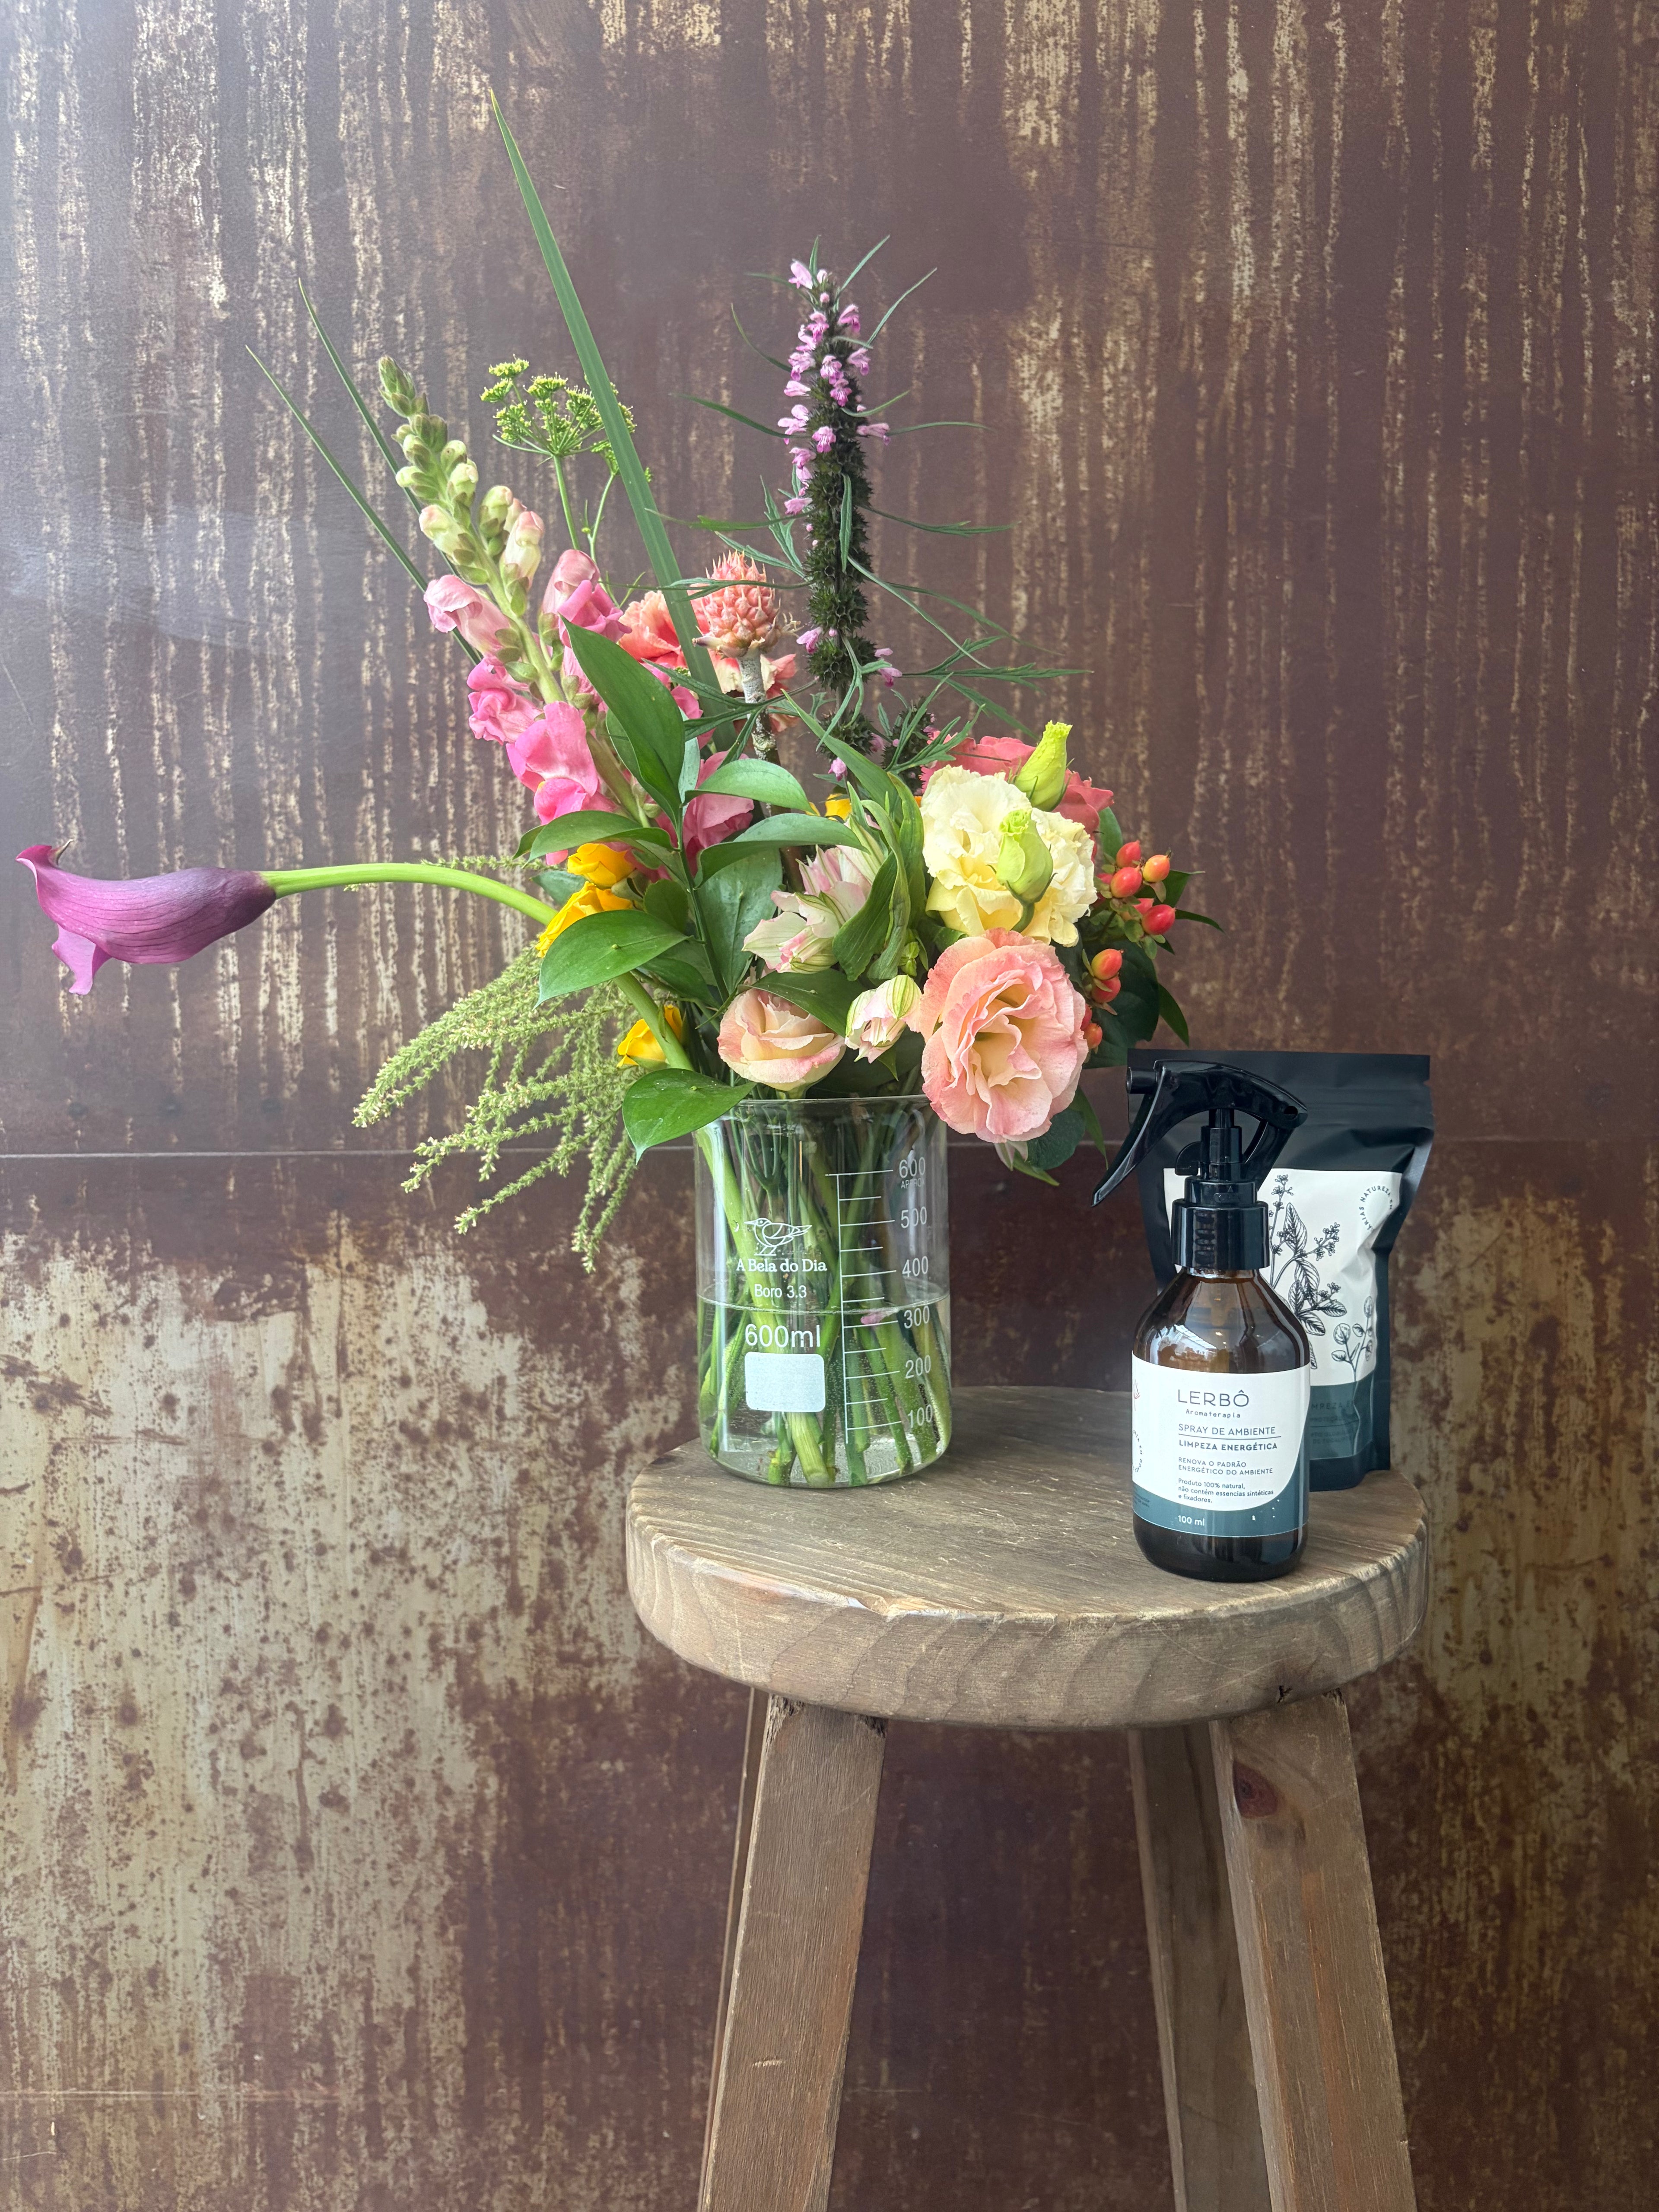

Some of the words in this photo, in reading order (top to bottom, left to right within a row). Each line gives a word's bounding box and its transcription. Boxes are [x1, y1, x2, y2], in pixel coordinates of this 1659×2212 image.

[899, 1157, 926, 1179] 600
[1360, 1185, 1391, 1202] NATUREZA
[900, 1206, 927, 1229] 500
[736, 1258, 746, 1271] A
[747, 1258, 778, 1272] Bela
[780, 1258, 799, 1272] do
[802, 1259, 828, 1272] Dia
[902, 1255, 929, 1278] 400
[754, 1284, 782, 1298] Boro
[786, 1285, 807, 1298] 3.3
[903, 1305, 930, 1329] 300
[745, 1323, 820, 1348] 600ml
[905, 1354, 931, 1379] 200
[1178, 1389, 1249, 1407] LERBÔ
[908, 1404, 933, 1428] 100
[1185, 1408, 1241, 1419] Aromaterapia
[1178, 1423, 1208, 1434] SPRAY
[1212, 1427, 1225, 1435] DE
[1228, 1427, 1276, 1436] AMBIENTE
[1179, 1439, 1218, 1450] LIMPEZA
[1221, 1442, 1278, 1451] ENERGÉTICA
[1178, 1457, 1206, 1466] RENOVA
[1178, 1465, 1224, 1475] ENERGÉTICO
[1178, 1478, 1202, 1487] Produto
[1183, 1494, 1213, 1503] fixadores.
[1178, 1515, 1192, 1524] 100
[1194, 1518, 1205, 1526] ml
